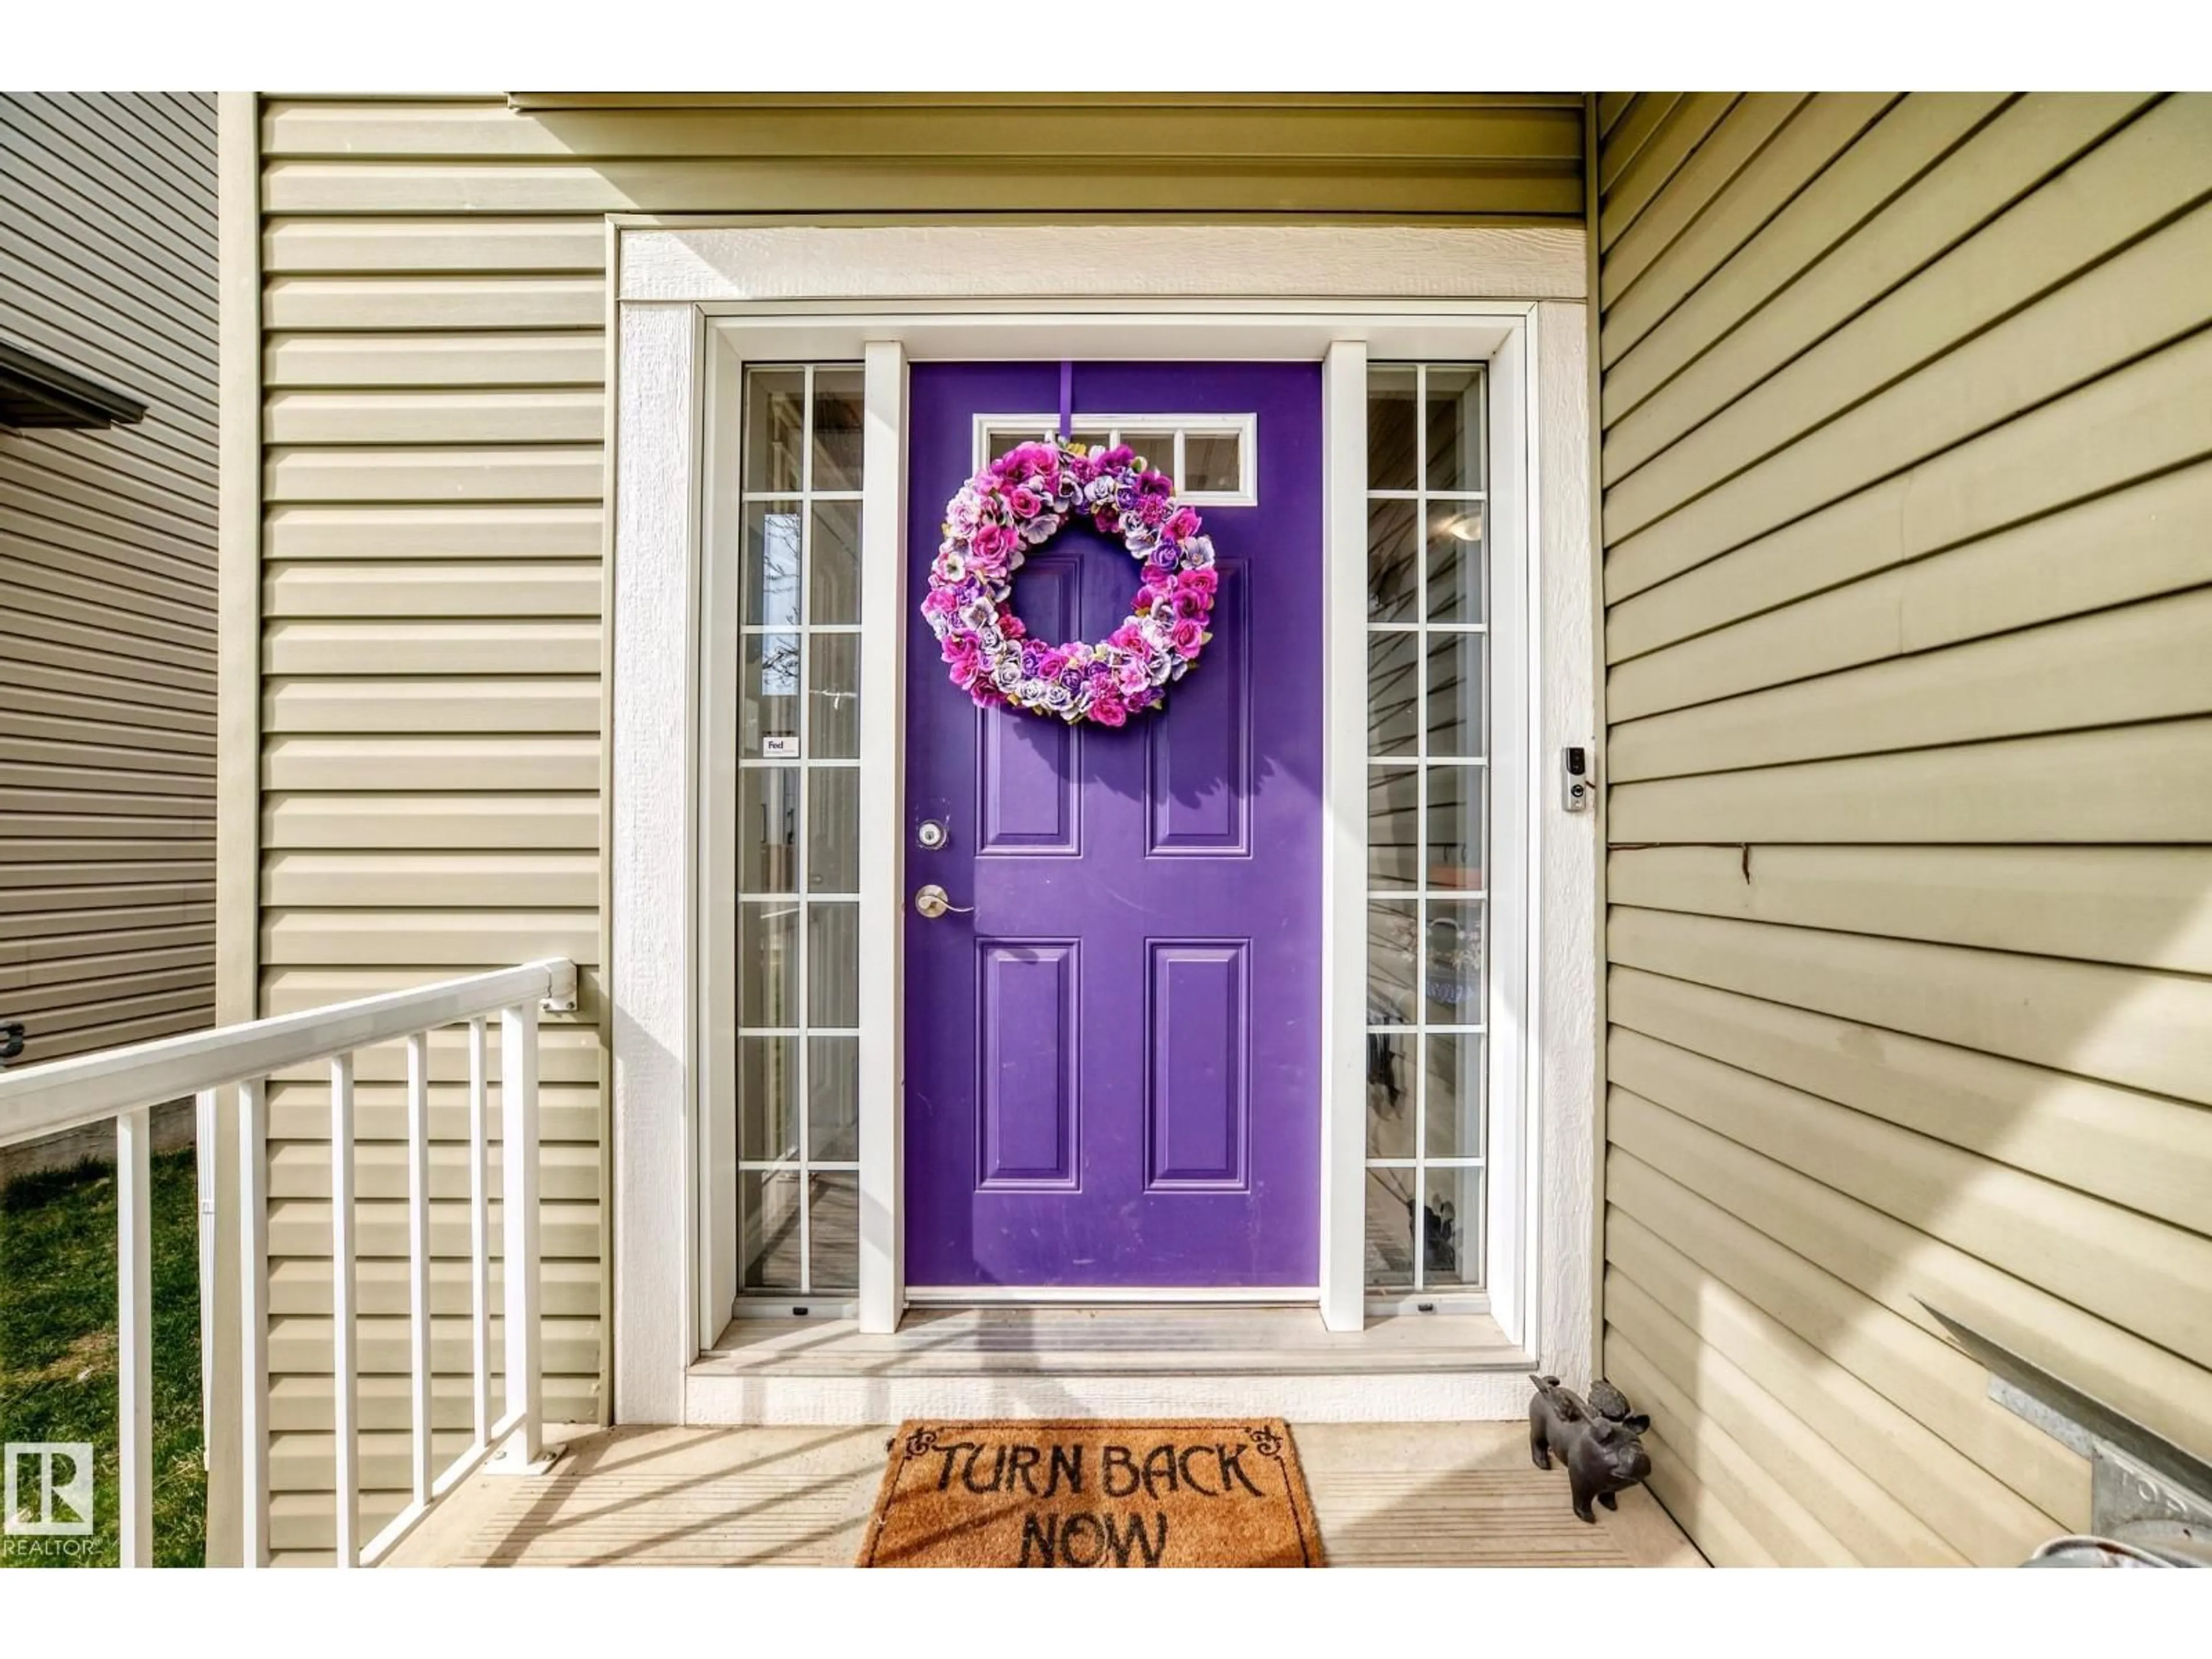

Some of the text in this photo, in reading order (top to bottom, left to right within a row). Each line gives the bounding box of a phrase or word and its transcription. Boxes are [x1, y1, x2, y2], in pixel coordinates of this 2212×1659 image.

[934, 1442, 1266, 1499] TURN BACK
[1019, 1512, 1168, 1567] NOW
